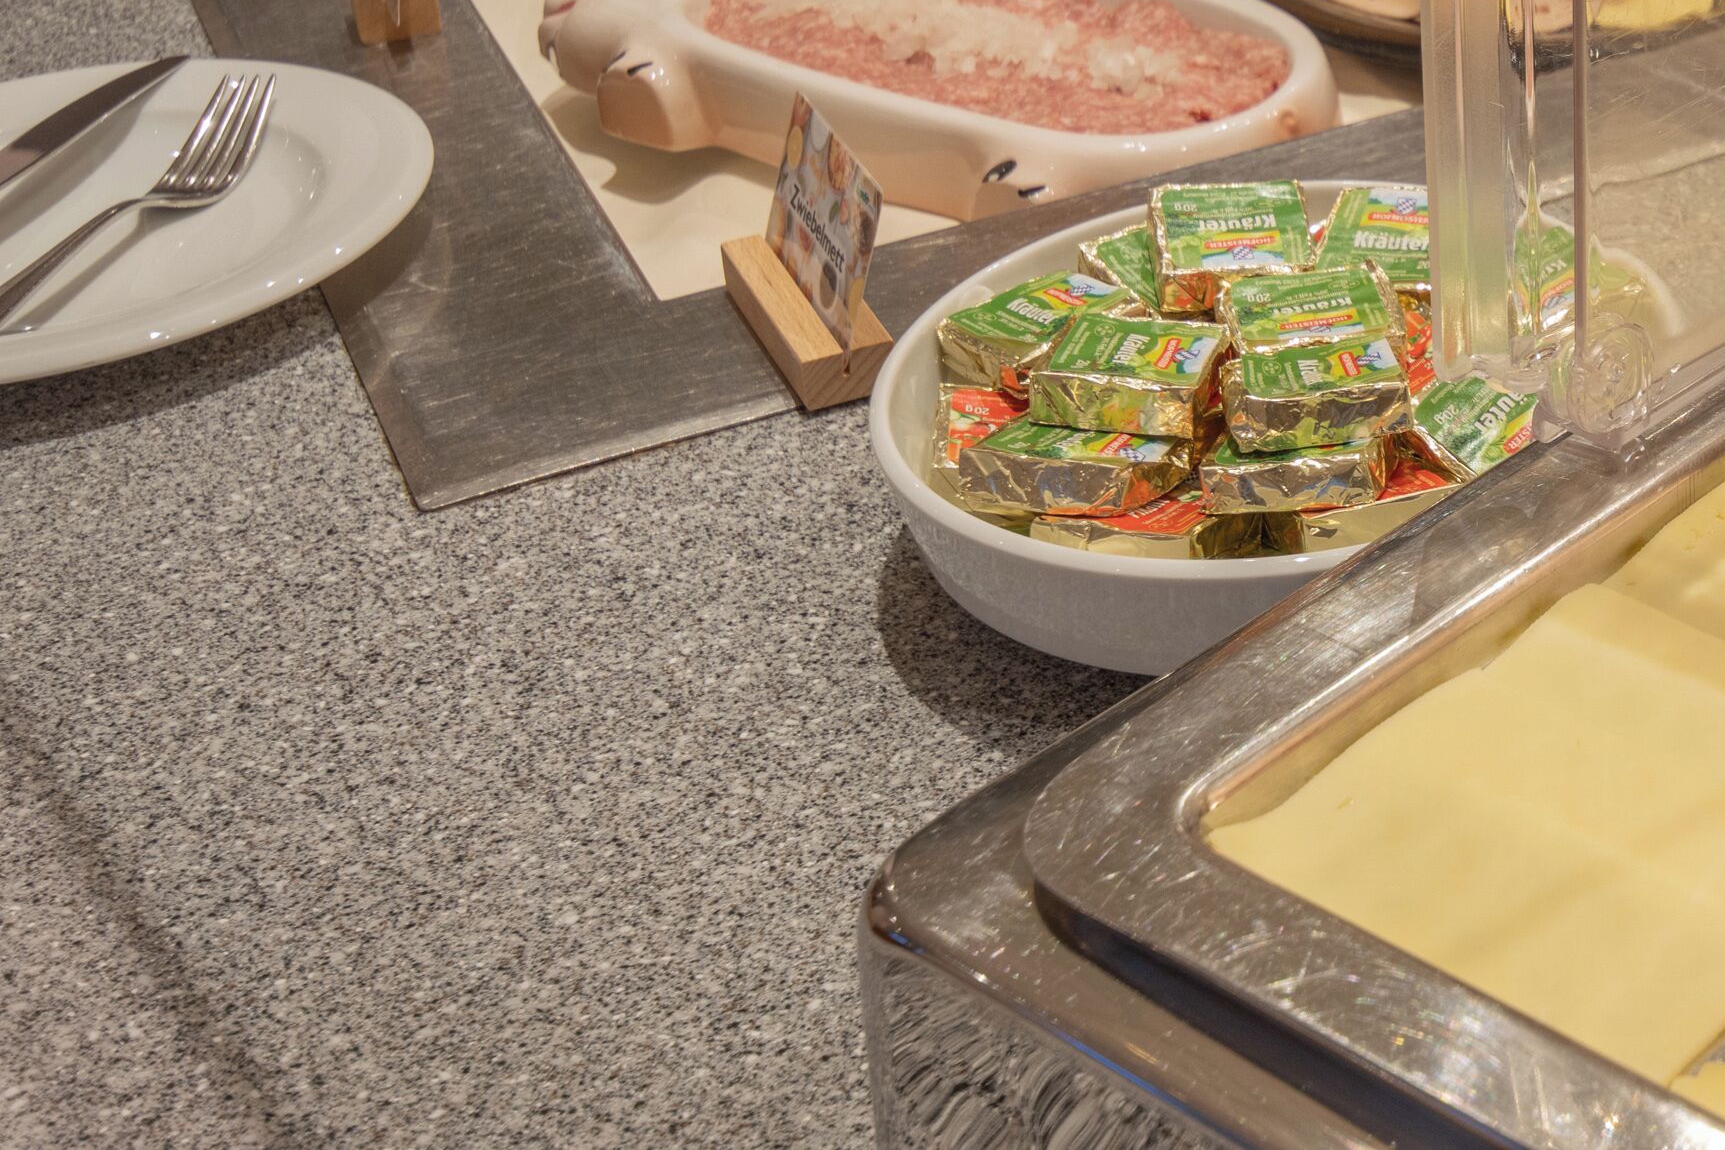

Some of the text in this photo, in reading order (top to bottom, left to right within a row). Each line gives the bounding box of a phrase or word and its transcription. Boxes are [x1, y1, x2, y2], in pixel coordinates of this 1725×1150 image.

[789, 183, 846, 274] Zwiebelmett
[1199, 213, 1277, 231] Kräuter
[1006, 297, 1056, 325] Kräuter
[1272, 296, 1353, 316] Kräuter
